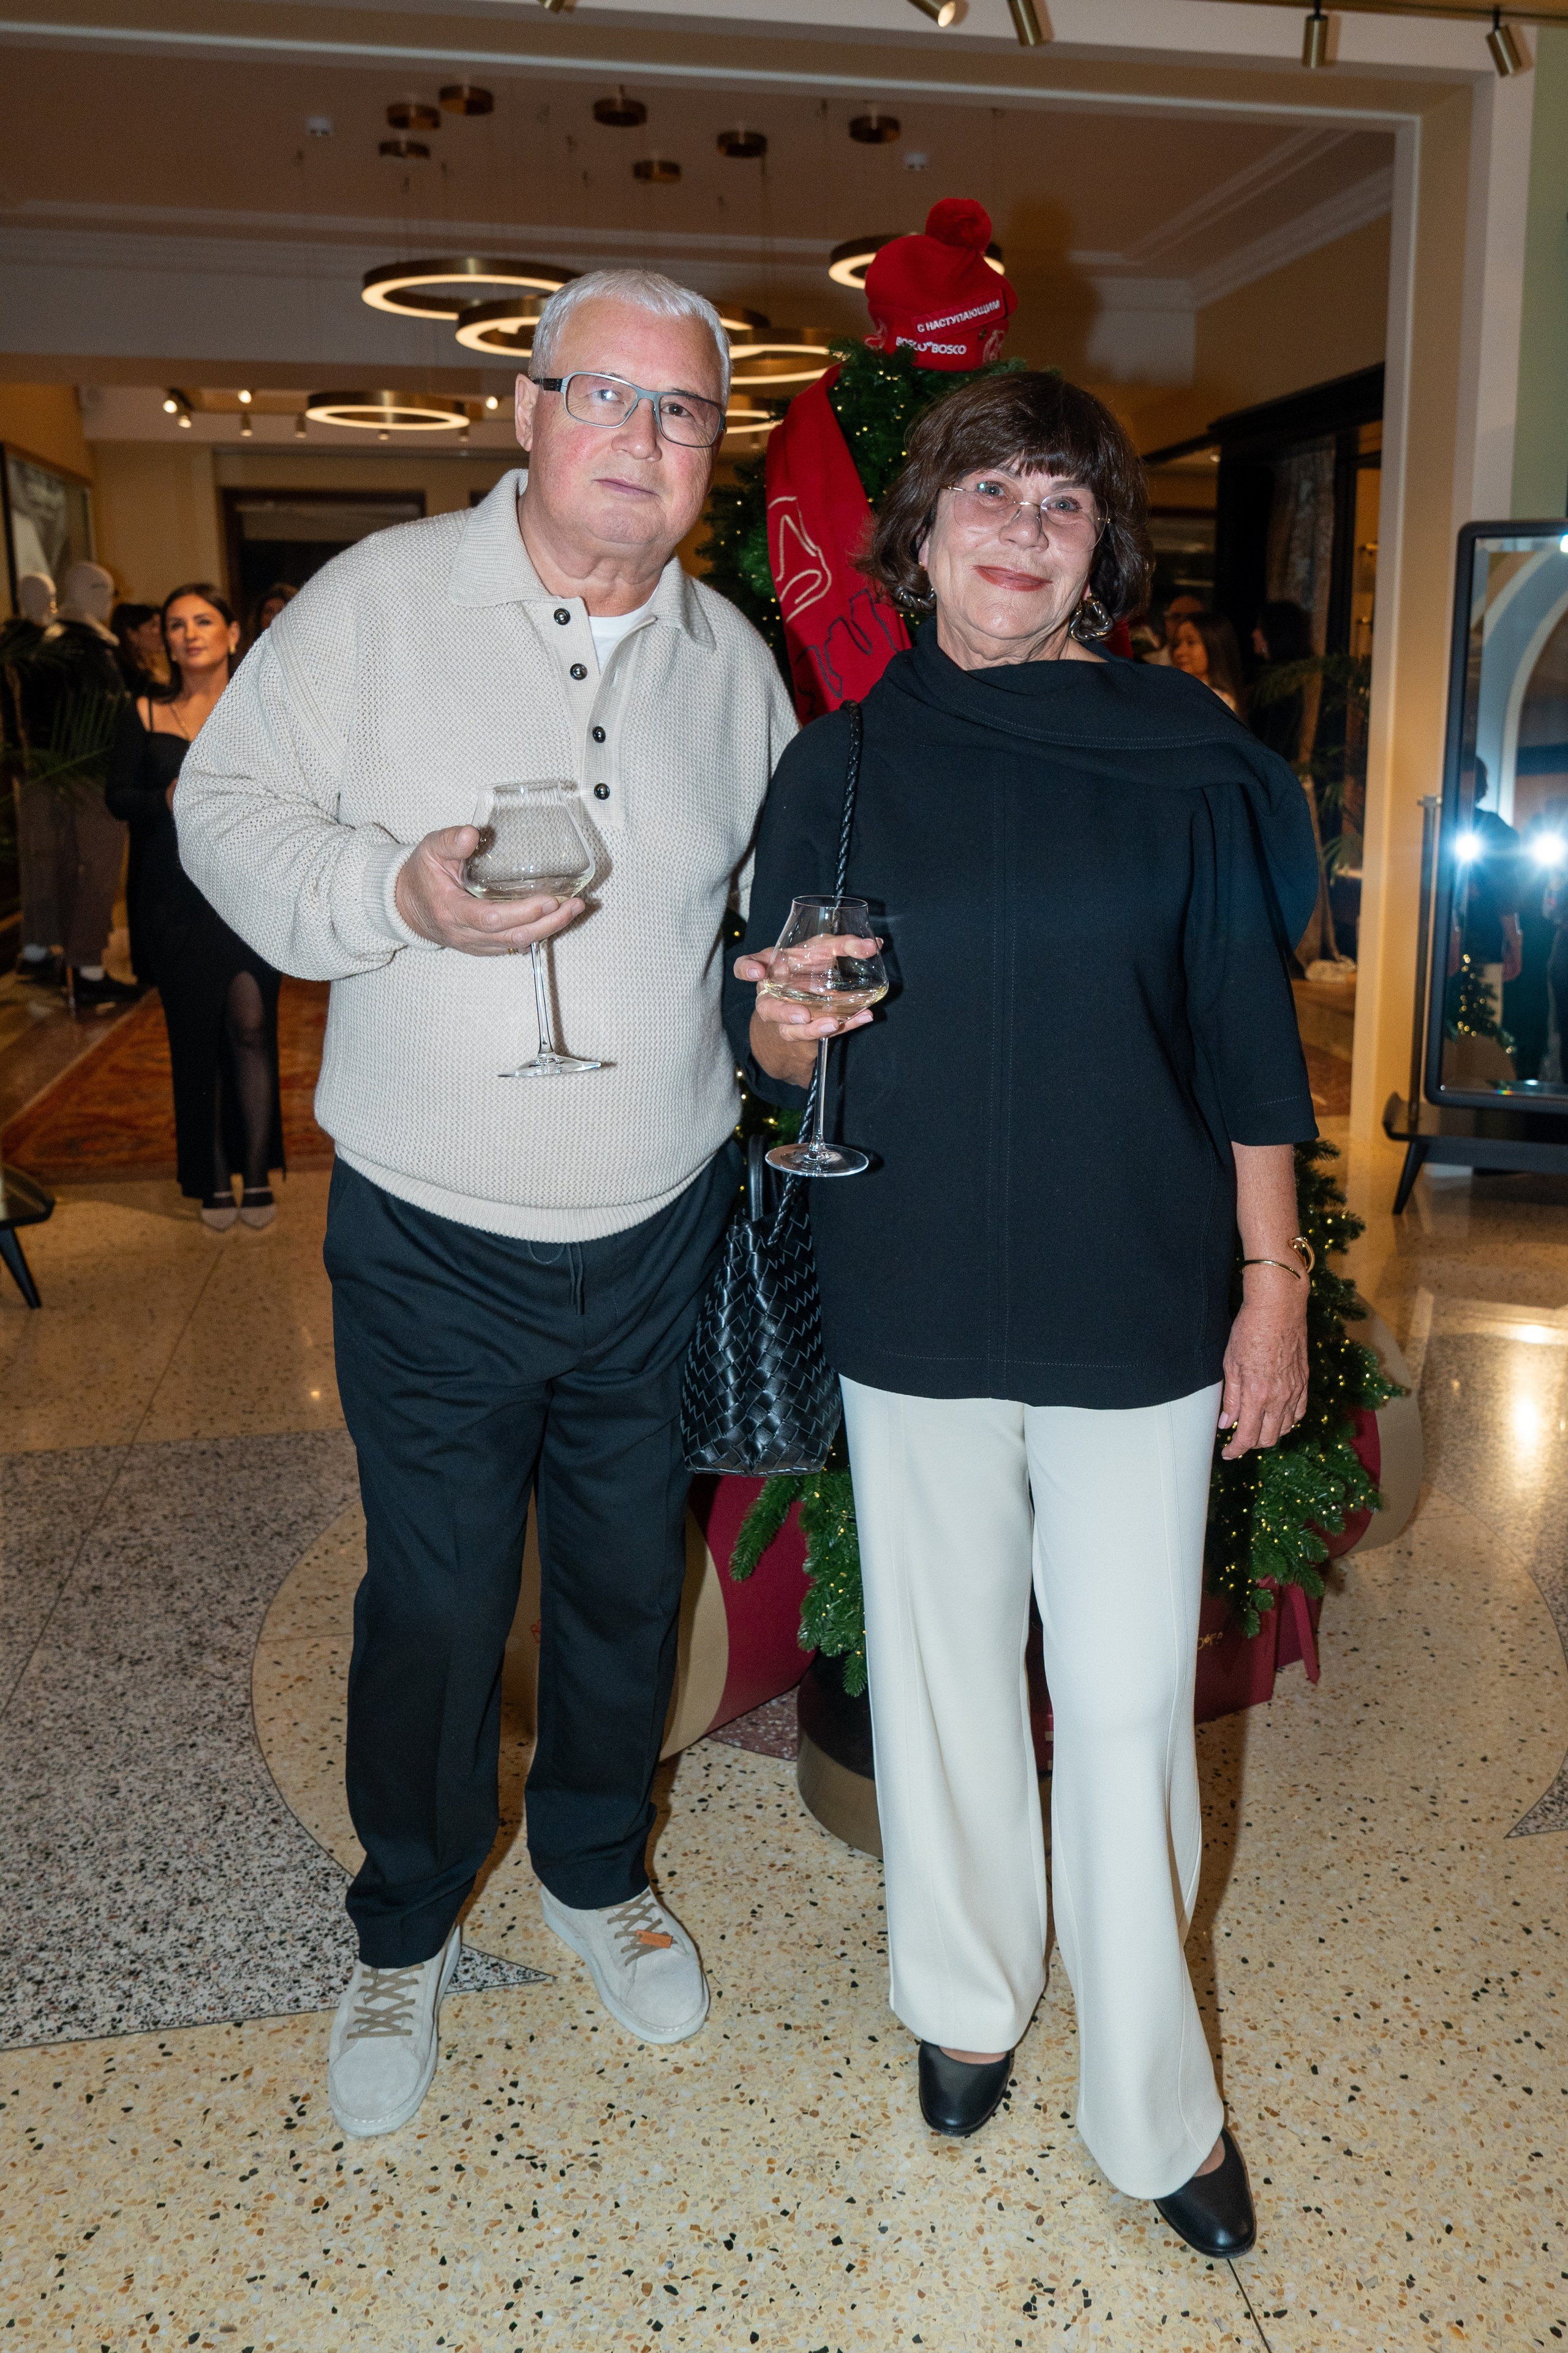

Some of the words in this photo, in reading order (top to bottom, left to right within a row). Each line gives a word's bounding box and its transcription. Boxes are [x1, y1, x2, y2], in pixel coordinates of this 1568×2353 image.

[917, 323, 925, 333] С
[925, 299, 1000, 331] НАСТУПАЮЩИМ
[931, 344, 967, 355] BOSCO
